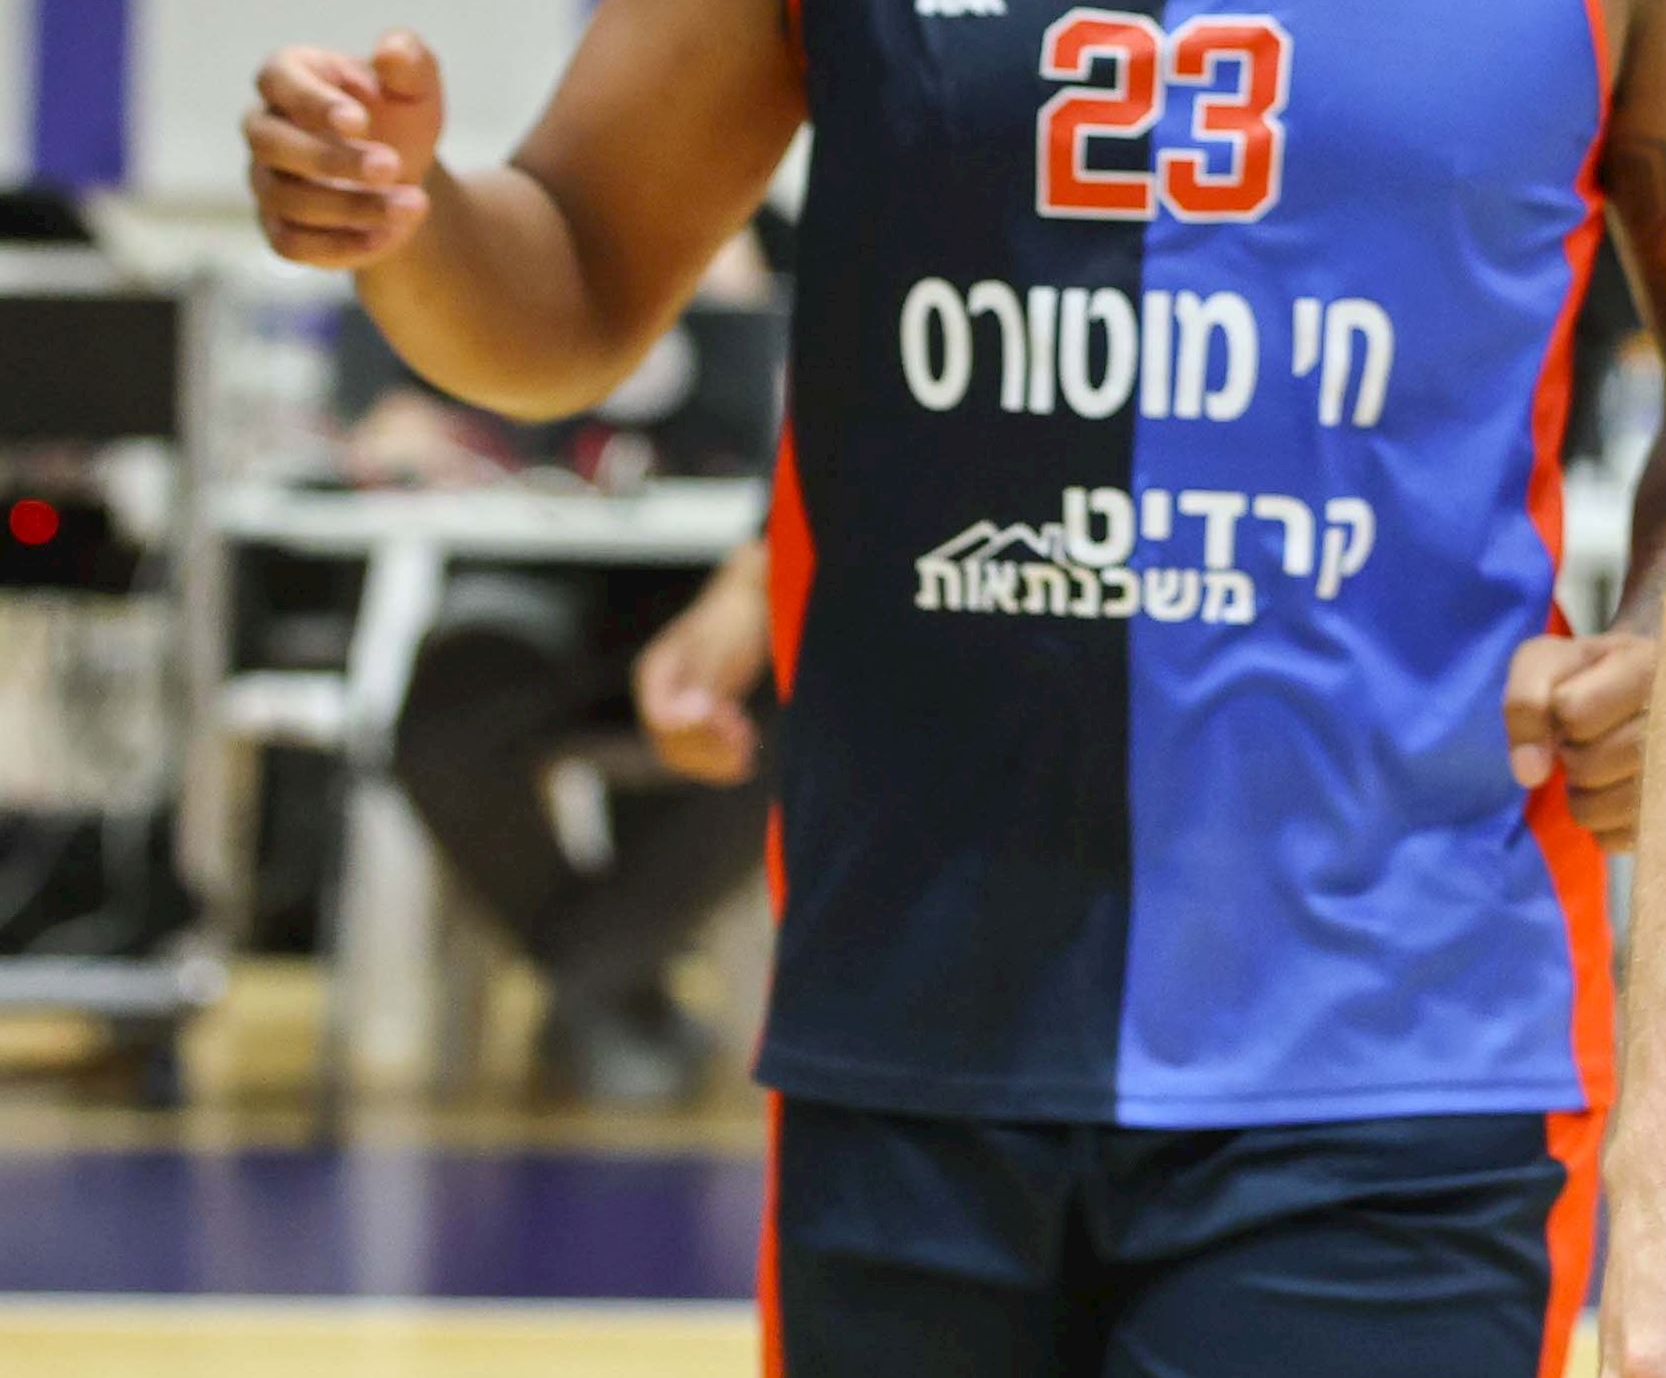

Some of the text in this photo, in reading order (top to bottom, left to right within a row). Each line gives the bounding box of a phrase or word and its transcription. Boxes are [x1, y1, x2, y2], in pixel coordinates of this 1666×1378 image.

[1036, 7, 1292, 222] 23
[901, 276, 1394, 427] חי מוטורס
[914, 556, 1255, 624] משכנתאות
[1063, 486, 1375, 600] קרדיט
